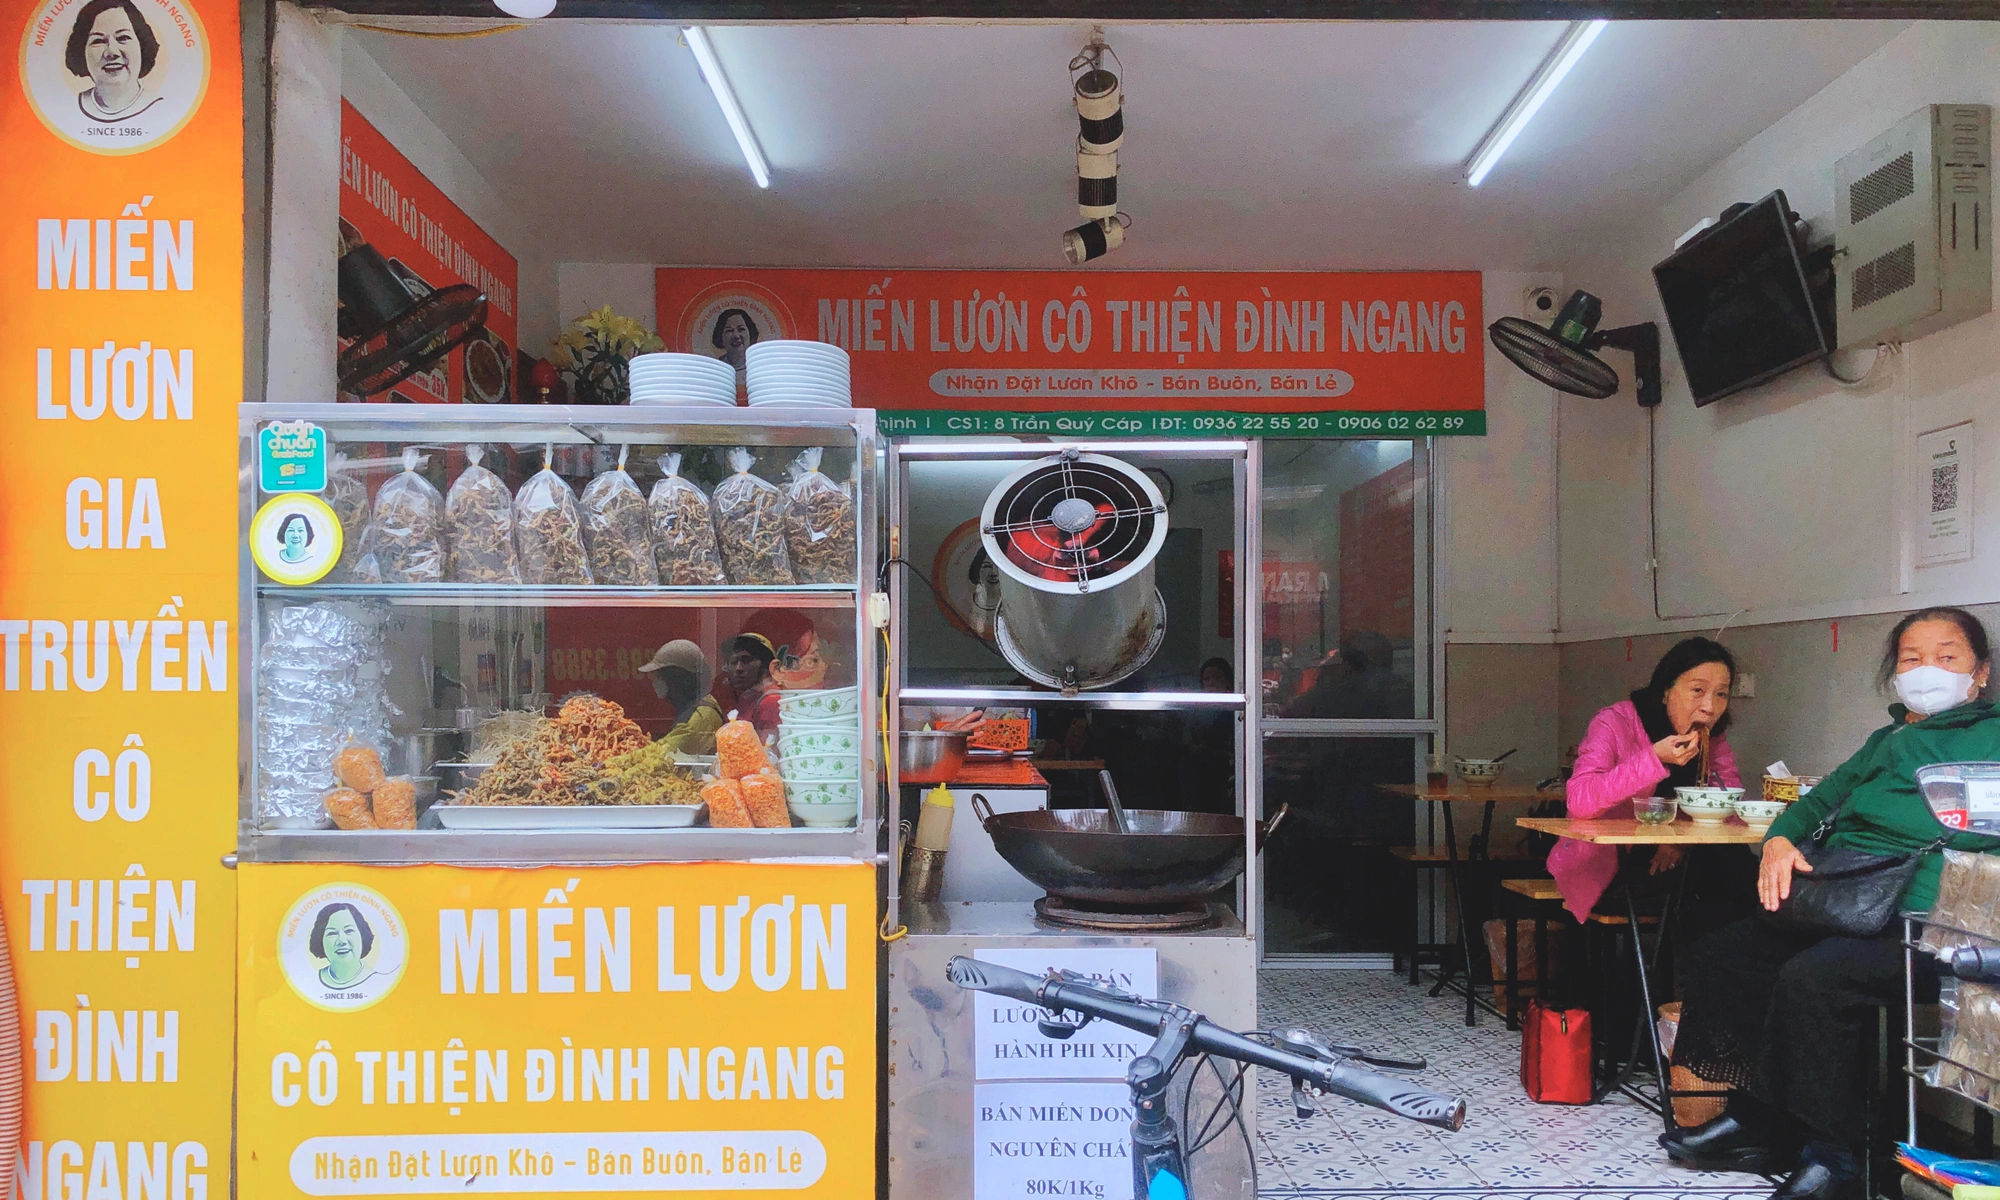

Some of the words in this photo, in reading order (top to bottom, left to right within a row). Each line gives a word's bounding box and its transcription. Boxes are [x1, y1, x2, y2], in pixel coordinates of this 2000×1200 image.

[168, 5, 196, 48] NGANG
[87, 127, 116, 137] SINCE
[118, 127, 143, 137] 1986
[36, 194, 195, 292] MIẾN
[339, 135, 362, 196] ẾN
[401, 196, 418, 241] CÔ
[420, 211, 453, 271] THIỆN
[480, 264, 513, 318] NGANG
[817, 276, 915, 352] MIẾN
[929, 288, 1029, 353] LƯƠN
[1042, 285, 1093, 354] CÔ
[1105, 285, 1221, 364] THIỆN
[1234, 285, 1326, 353] ĐÌNH
[1341, 299, 1466, 354] NGANG
[36, 340, 195, 421] LƯƠN
[946, 374, 999, 391] Nhận
[1005, 375, 1042, 391] Đặt
[1048, 376, 1093, 390] Lươn
[1100, 375, 1139, 391] Khô
[1162, 375, 1200, 391] Bán
[1207, 375, 1263, 393] Buôn,
[1270, 375, 1308, 391] Bán
[1315, 376, 1338, 391] Lẻ
[879, 416, 917, 432] hịnh
[946, 416, 988, 431] CS1:
[994, 417, 1006, 431] 8
[1010, 416, 1050, 431] Trần
[1056, 416, 1095, 433] Quý
[1101, 415, 1143, 434] Cáp
[1192, 416, 1237, 430] 0936
[1241, 416, 1265, 430] 22
[1269, 416, 1292, 430] 55
[1297, 416, 1320, 430] 20
[1338, 416, 1383, 430] 0906
[1387, 416, 1410, 430] 02
[1415, 416, 1438, 430] 62
[1442, 416, 1465, 430] 89
[64, 477, 168, 551] GIA
[0, 595, 229, 693] TRUYỀN
[1625, 635, 1633, 662] 2
[1830, 621, 1839, 653] 1
[72, 732, 153, 823] CÔ
[21, 863, 197, 970] THIỆN
[320, 891, 333, 902] CÔ
[380, 907, 400, 938] NGANG
[437, 877, 631, 994] MIẾN
[658, 894, 848, 993] LƯƠN
[324, 992, 345, 1000] SINCE
[346, 992, 364, 1000] 1986
[33, 993, 180, 1084] ĐÌNH
[994, 1038, 1054, 1059] HÀNH
[1061, 1043, 1095, 1058] PHI
[1102, 1043, 1138, 1063] XỊN
[271, 1040, 339, 1109] CÔ
[354, 1037, 509, 1117] THIỆN
[524, 1036, 650, 1104] ĐÌNH
[668, 1045, 846, 1103] NGANG
[981, 1103, 1023, 1122] BÁN
[1028, 1101, 1084, 1122] MIẾN
[1089, 1106, 1134, 1122] DON
[8, 1140, 209, 1200] NGANG
[315, 1151, 379, 1183] Nhận
[388, 1150, 431, 1182] Đặt
[440, 1149, 498, 1178] Lươn
[508, 1148, 554, 1177] Khô
[587, 1146, 632, 1177] Bán
[642, 1145, 712, 1178] Buôn,
[722, 1144, 767, 1175] Bán
[776, 1144, 803, 1174] Lẻ
[988, 1137, 1077, 1158] NGUYÊN
[1082, 1137, 1132, 1158] CHẤ
[1026, 1179, 1105, 1199] 80K/1Kg
